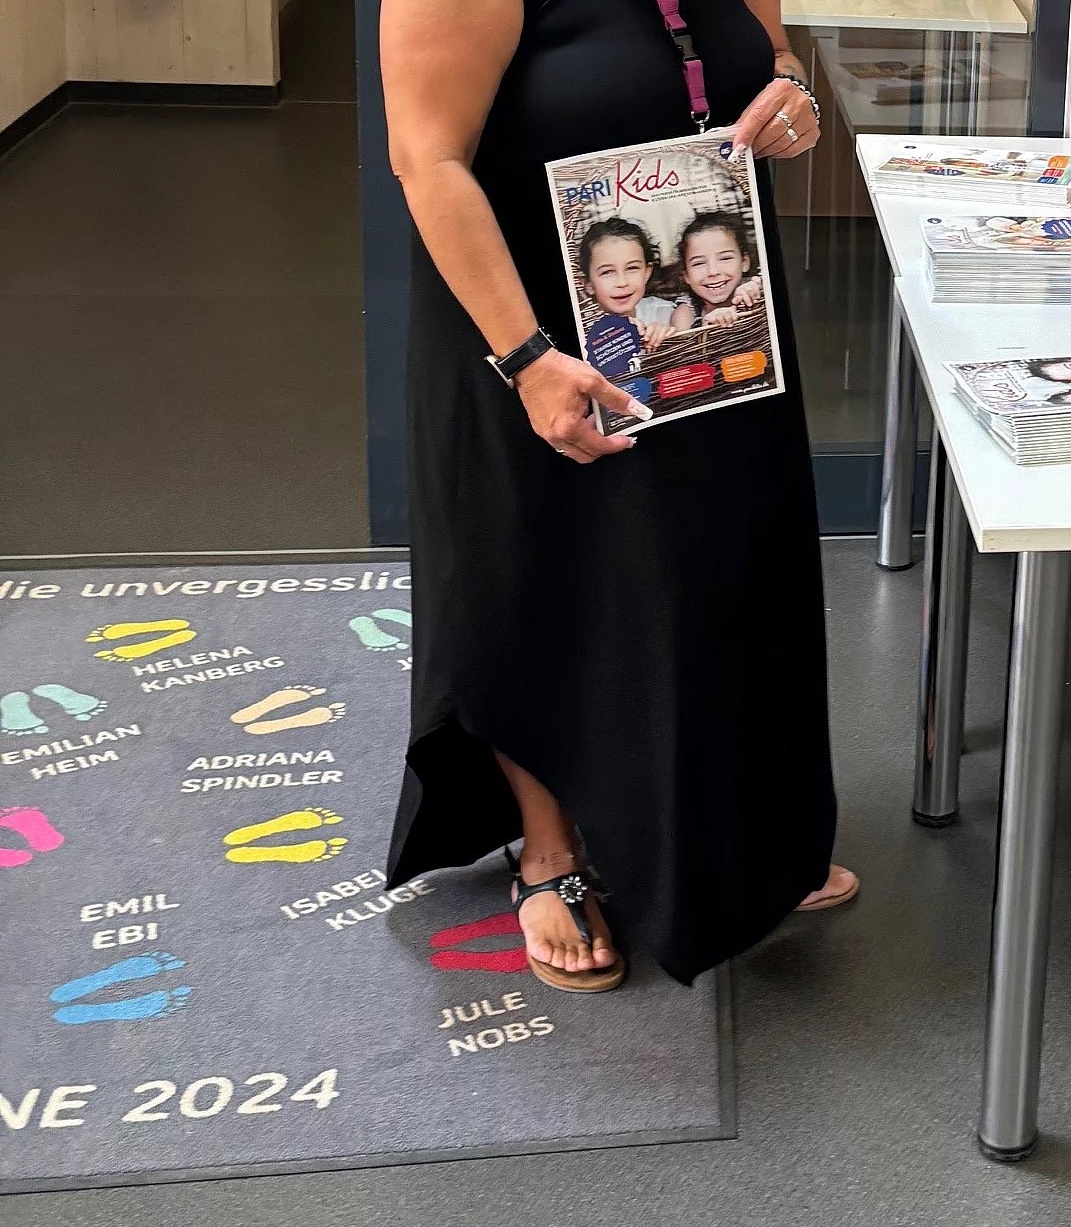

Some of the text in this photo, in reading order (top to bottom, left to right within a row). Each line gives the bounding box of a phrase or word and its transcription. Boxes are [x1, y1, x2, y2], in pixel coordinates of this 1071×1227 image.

[565, 178, 611, 206] PARI
[615, 157, 680, 207] Kids
[131, 646, 254, 677] HELENA
[140, 656, 285, 693] KANBERG
[1, 724, 143, 766] EMILIAN
[186, 749, 336, 772] ADRIANA
[32, 749, 120, 780] HEIM
[180, 769, 344, 793] SPINDLER
[79, 893, 180, 924] EMIL
[325, 879, 438, 931] KLUGE
[91, 922, 158, 950] EBI
[437, 991, 527, 1030] JULE
[447, 1015, 556, 1057] NOBS
[122, 1069, 341, 1123] 2024
